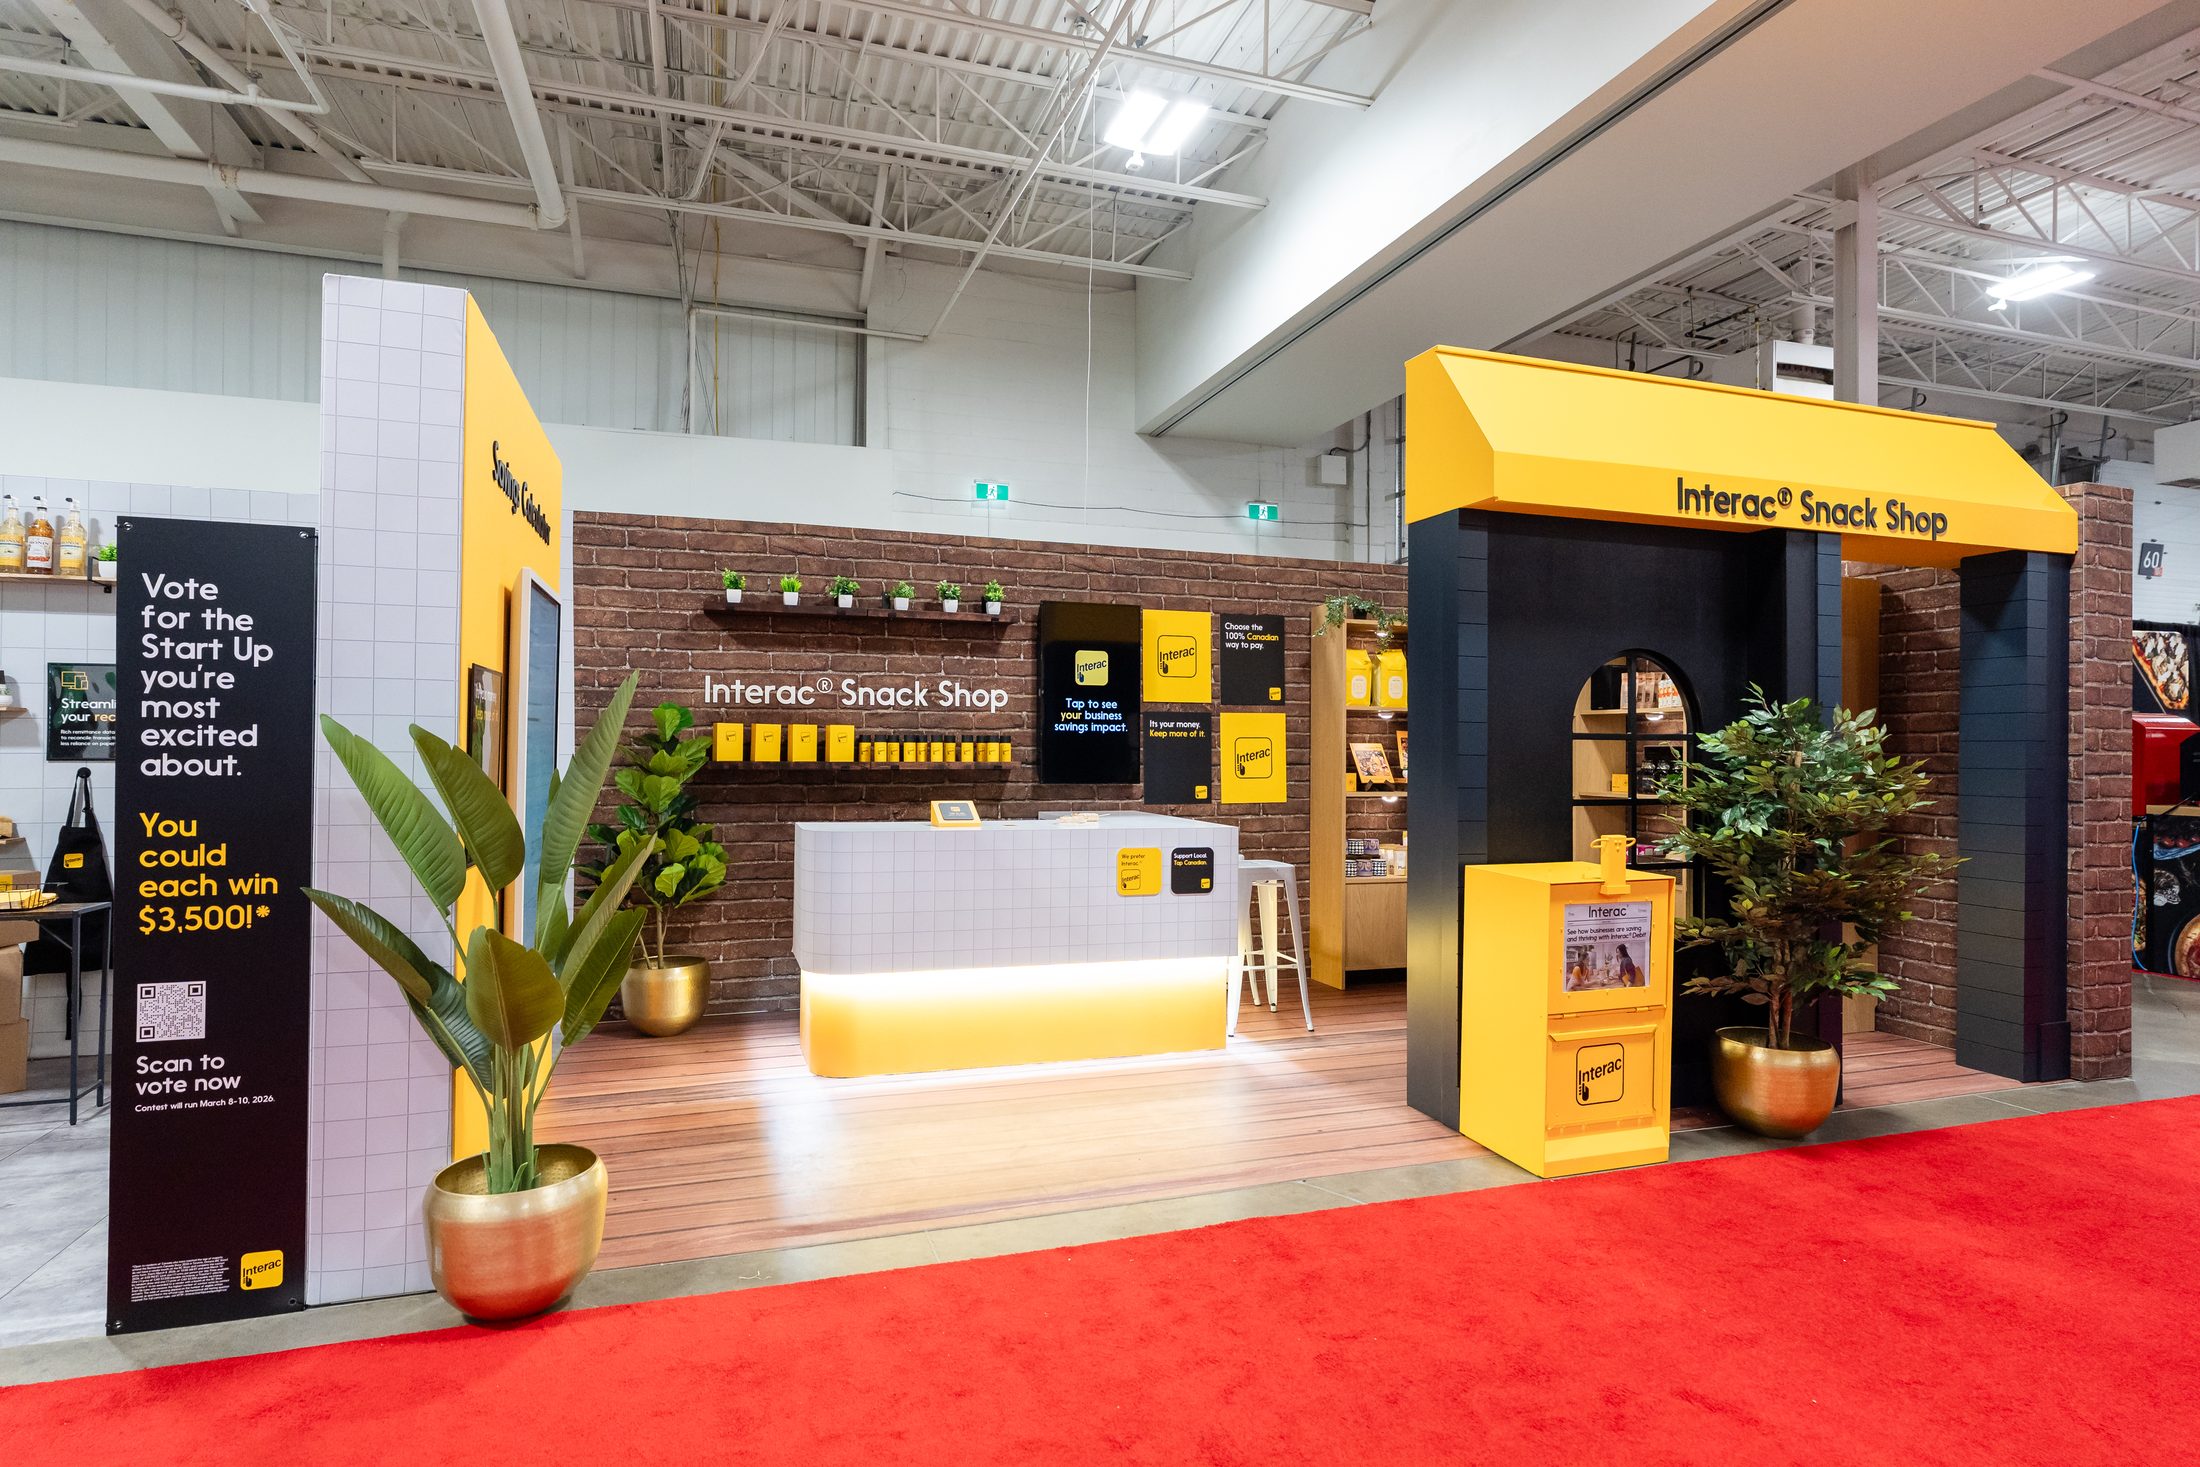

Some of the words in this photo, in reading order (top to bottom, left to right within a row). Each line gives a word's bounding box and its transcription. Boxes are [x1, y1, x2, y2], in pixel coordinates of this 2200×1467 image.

[492, 440, 520, 515] Savings
[1800, 489, 1877, 529] Snack
[1886, 498, 1948, 541] Shop
[2143, 551, 2160, 569] 60
[142, 573, 218, 600] Vote
[141, 605, 190, 629] for
[201, 608, 253, 631] the
[1224, 622, 1250, 630] Choose
[1225, 632, 1245, 640] 100%
[1246, 633, 1279, 641] Canadian
[1225, 642, 1239, 650] way
[1250, 642, 1264, 650] pay.
[142, 633, 223, 660] Start
[234, 637, 273, 667] Up
[1160, 647, 1194, 662] Interac
[1076, 660, 1107, 673] Interac
[141, 664, 235, 694] you're
[704, 675, 833, 705] Interac®
[841, 678, 928, 707] Snack
[938, 680, 1008, 714] Shop
[1065, 698, 1085, 710] Tap
[1087, 700, 1099, 708] to
[1101, 701, 1118, 709] see
[141, 697, 220, 718] most
[1060, 712, 1082, 721] your
[1084, 711, 1122, 721] business
[61, 713, 91, 724] your
[1054, 722, 1088, 734] savings
[1091, 722, 1128, 734] impact.
[1159, 721, 1175, 729] your
[1176, 721, 1201, 729] money.
[141, 724, 257, 746] excited
[1149, 729, 1168, 738] Keep
[140, 753, 241, 776] about.
[1236, 748, 1271, 764] Interac
[139, 812, 197, 838] You
[139, 843, 227, 867] could
[139, 873, 217, 898] each
[228, 873, 278, 895] win
[136, 1055, 193, 1075] Scan
[200, 1054, 225, 1070] to
[1578, 1058, 1622, 1086] Interac
[135, 1077, 188, 1096] vote
[194, 1075, 242, 1092] now
[134, 1103, 168, 1112] Contest
[170, 1102, 183, 1110] will
[184, 1101, 198, 1109] run
[200, 1099, 226, 1108] March
[228, 1097, 250, 1105] 8-10,
[242, 1259, 282, 1278] Interac
